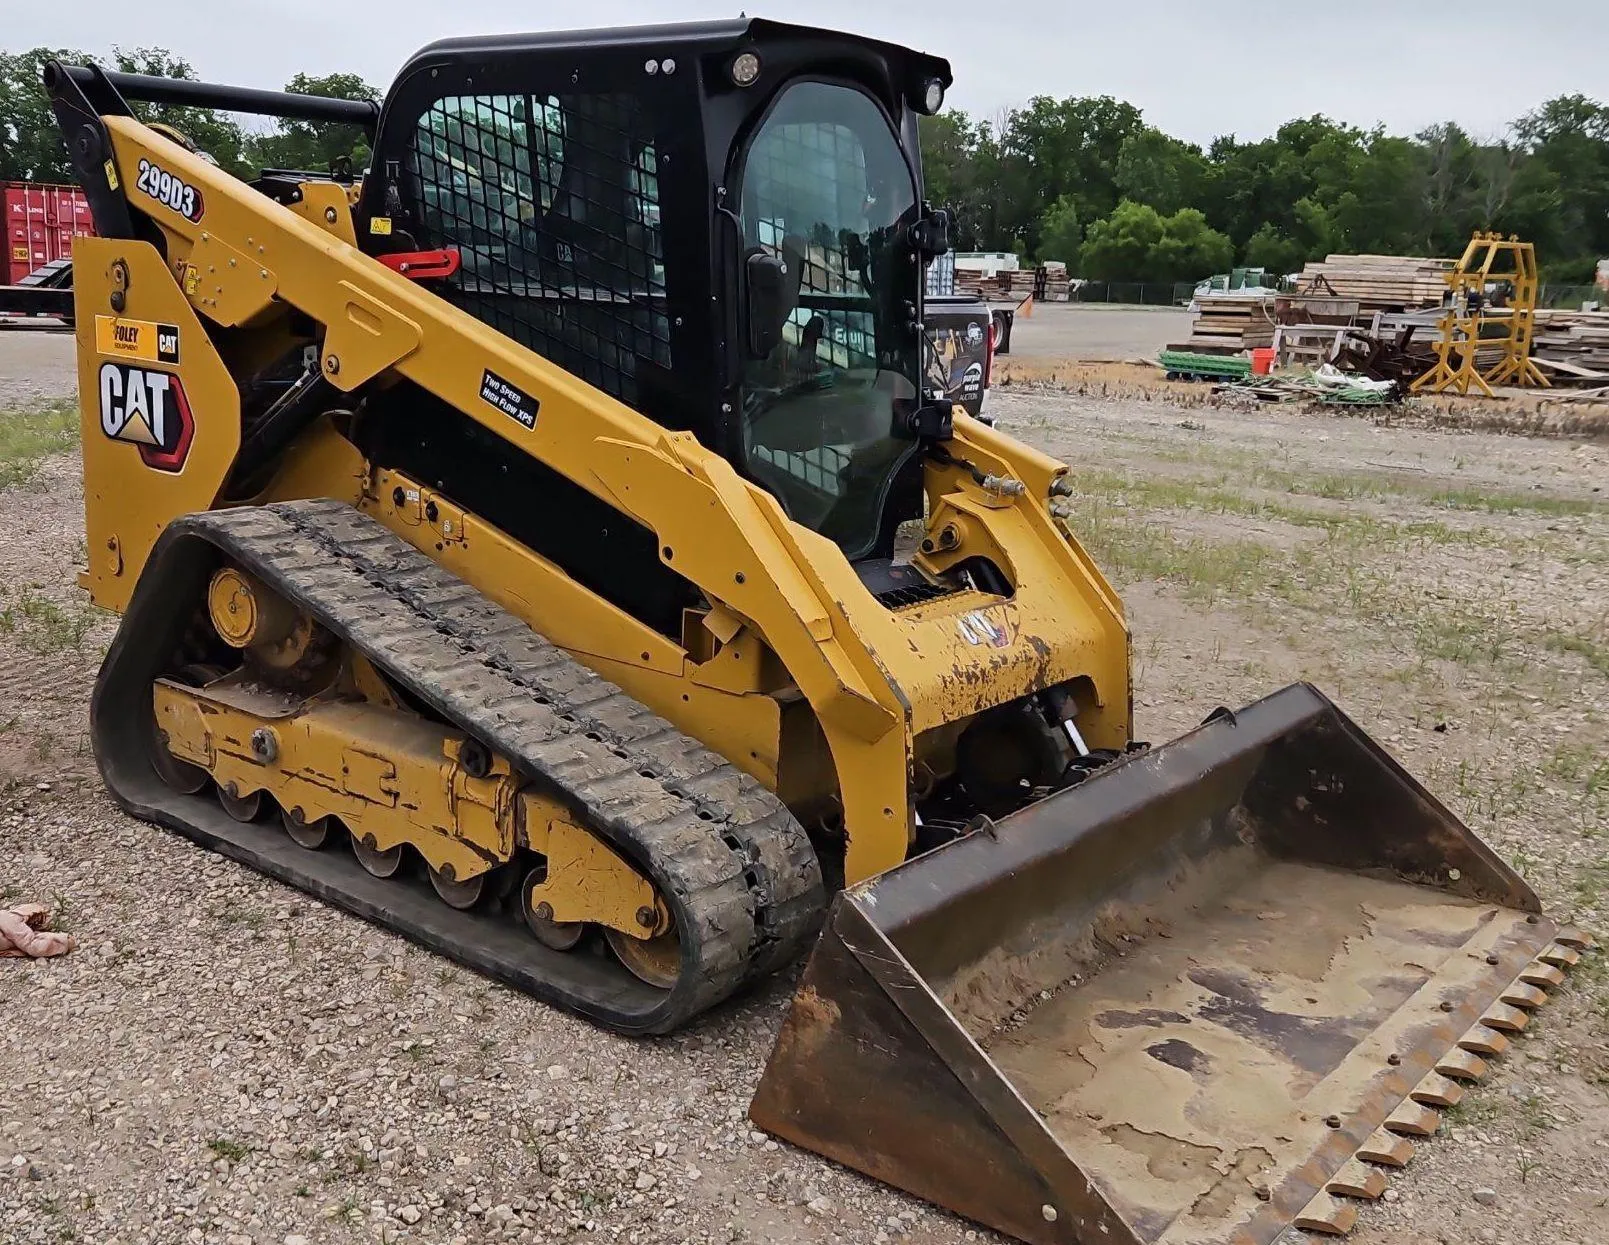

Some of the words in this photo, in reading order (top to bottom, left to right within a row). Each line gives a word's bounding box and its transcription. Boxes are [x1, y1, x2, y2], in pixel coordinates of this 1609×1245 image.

[138, 160, 195, 217] 299D3
[114, 325, 139, 343] FOLEY
[114, 342, 138, 351] EQUIPMENT
[159, 334, 177, 354] CAT
[100, 364, 169, 447] CAT
[517, 409, 533, 425] XPS
